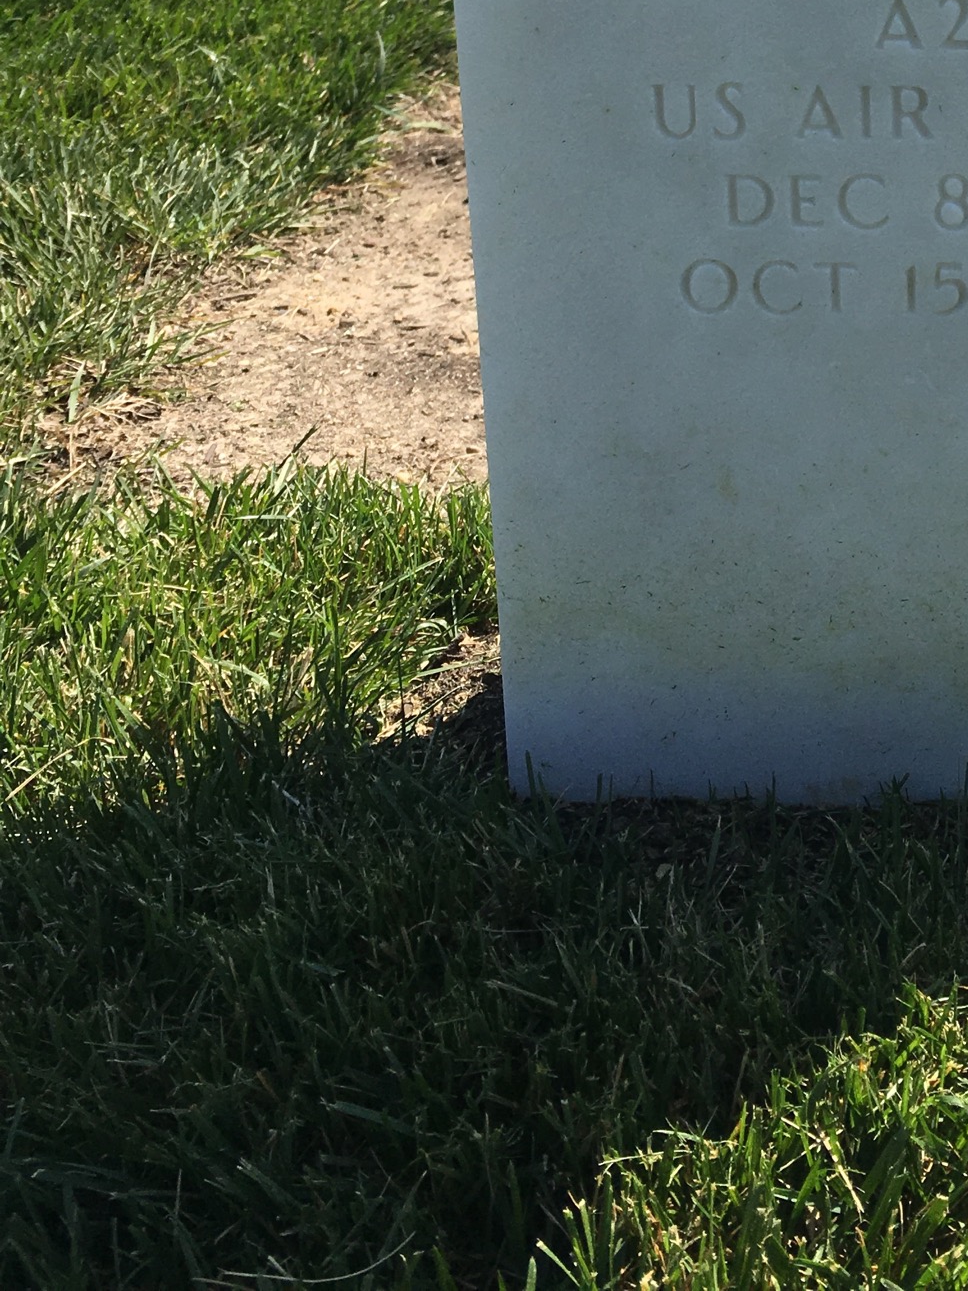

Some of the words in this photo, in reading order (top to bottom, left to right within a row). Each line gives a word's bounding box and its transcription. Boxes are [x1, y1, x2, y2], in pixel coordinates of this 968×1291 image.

[651, 81, 747, 141] US
[797, 83, 934, 140] AIR
[725, 173, 890, 230] DEC
[680, 258, 859, 314] OCT
[905, 261, 968, 316] 15
